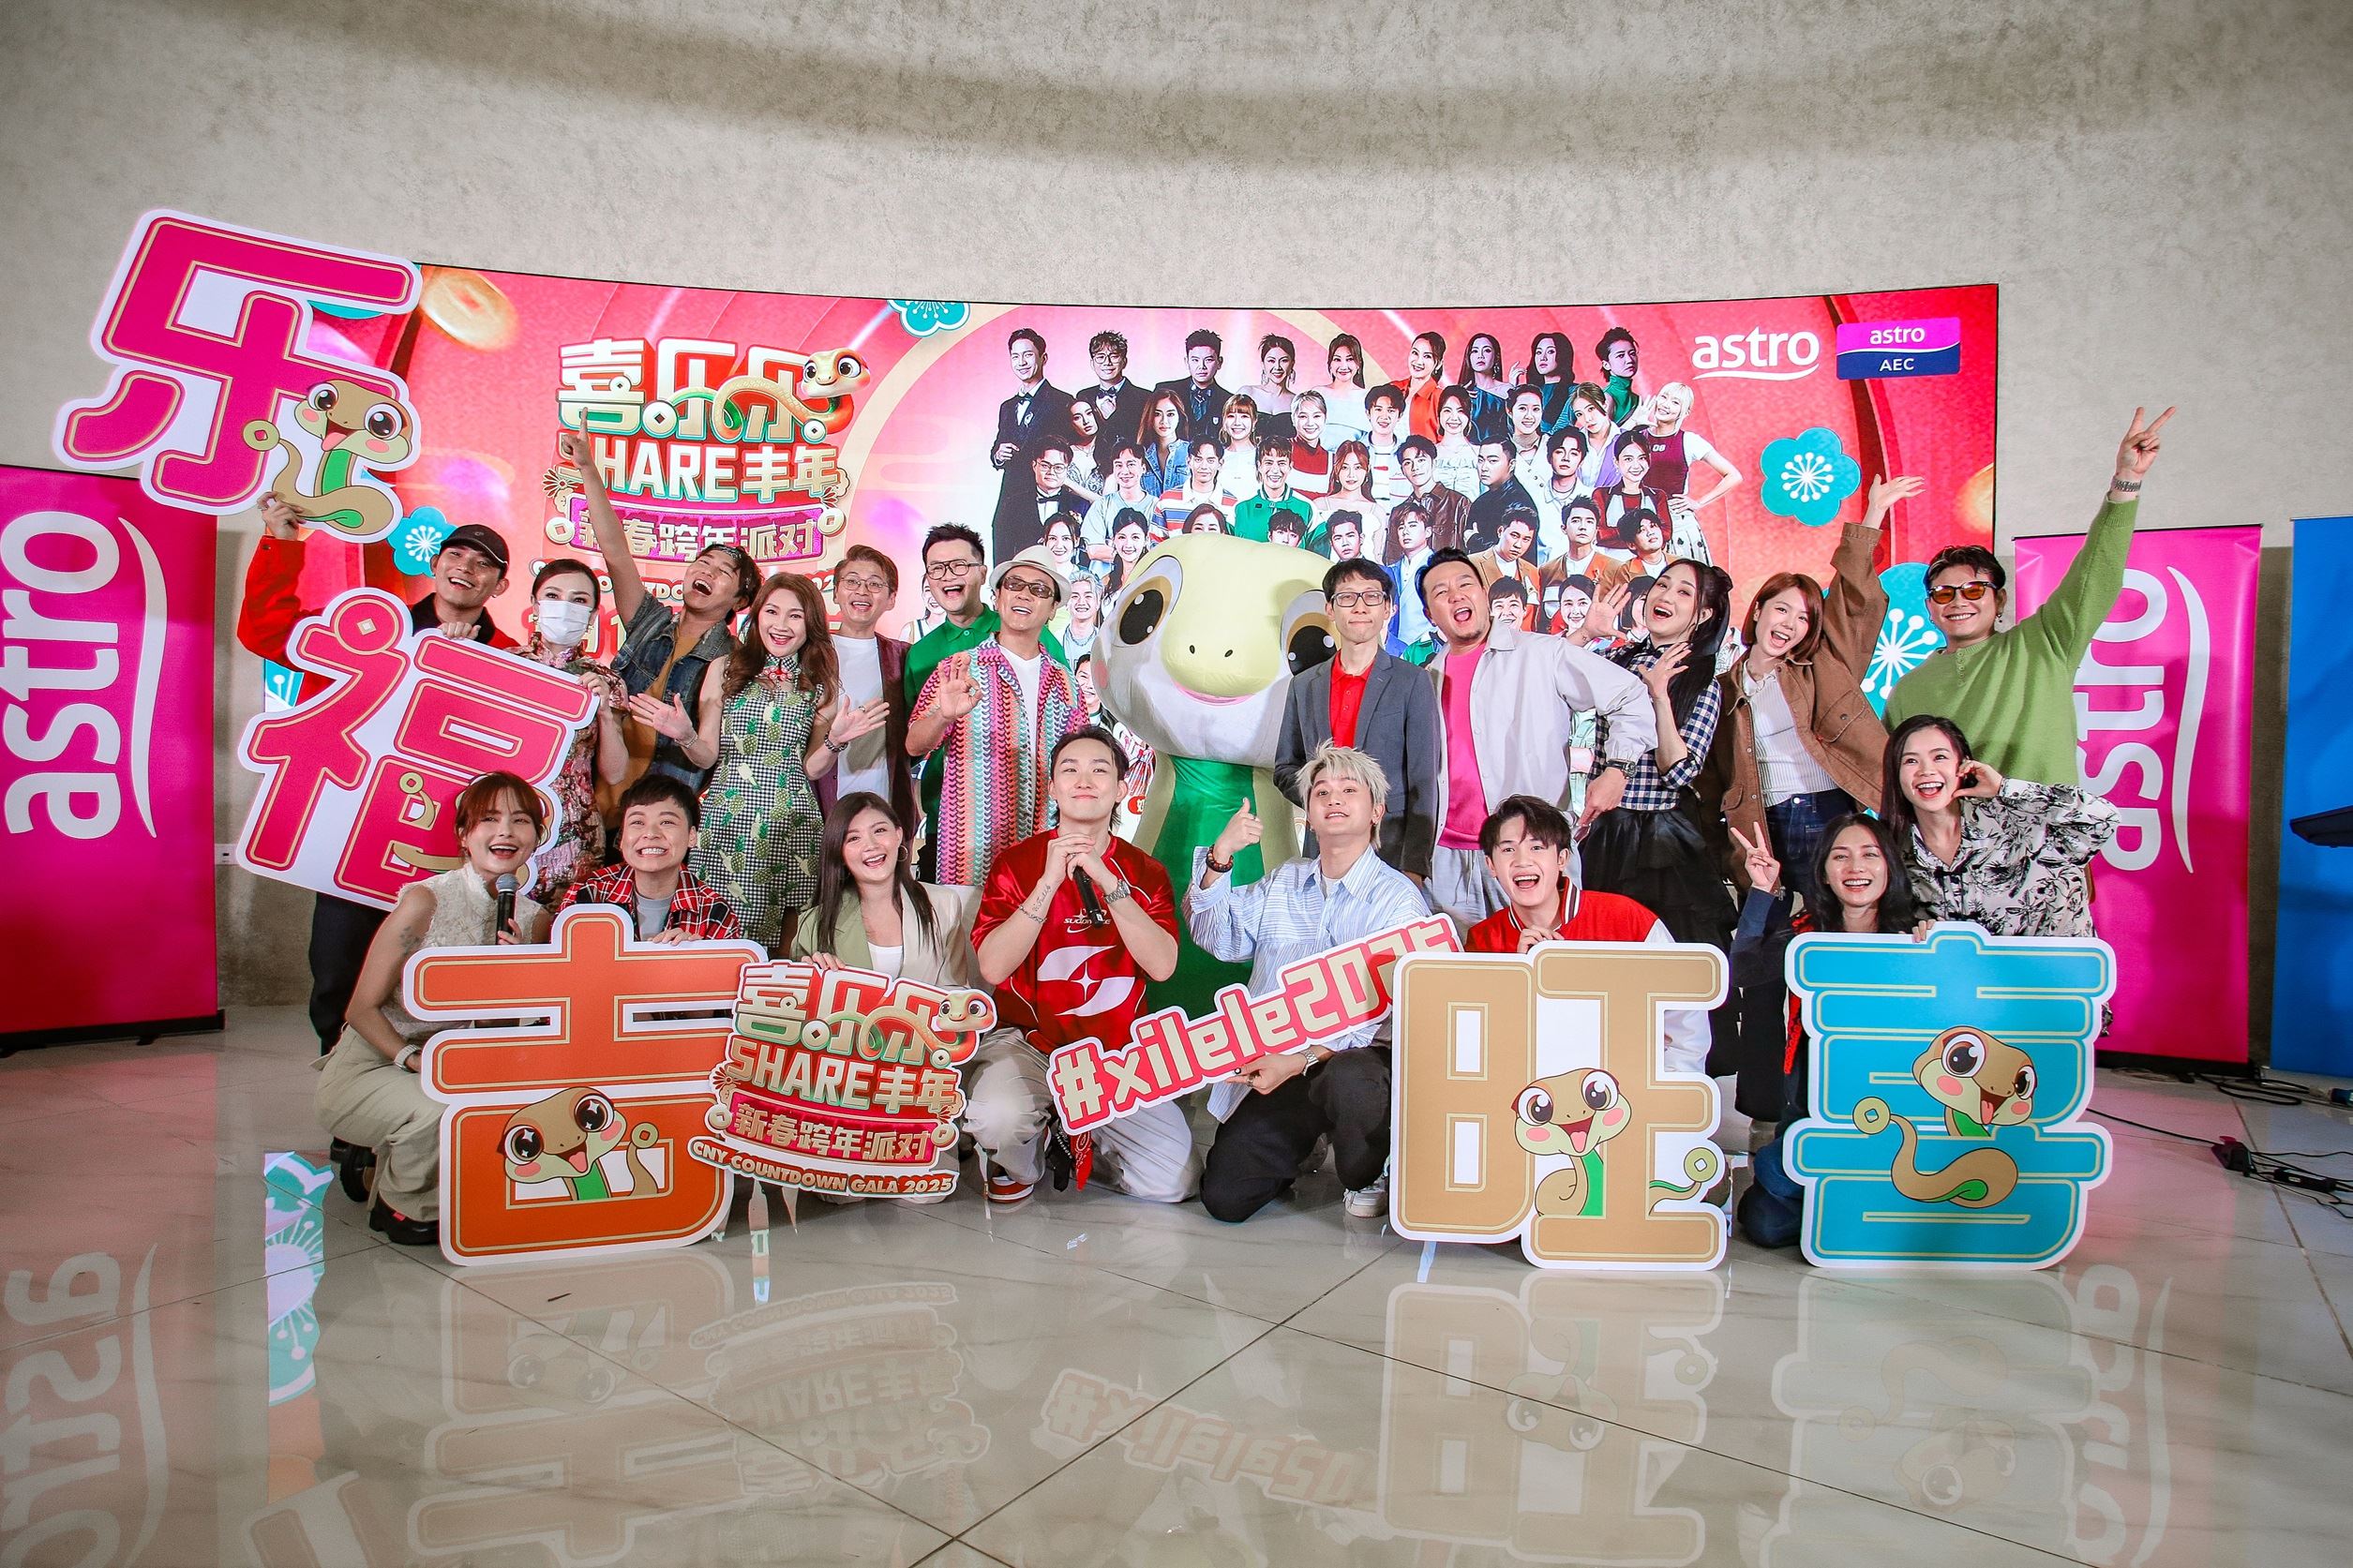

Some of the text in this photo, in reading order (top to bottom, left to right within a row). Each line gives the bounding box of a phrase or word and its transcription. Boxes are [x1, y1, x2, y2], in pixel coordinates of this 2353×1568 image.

[62, 216, 414, 503] 乐
[1691, 326, 1820, 369] astro
[1869, 325, 1926, 345] astro
[1879, 358, 1915, 372] AEC
[743, 446, 838, 502] 丰年
[0, 511, 121, 840] astro
[246, 594, 592, 903] 福
[414, 912, 764, 1257] 吉
[727, 1038, 958, 1113] SHARE 丰年
[1398, 946, 1722, 1262] 旺
[1792, 931, 2111, 1262] 喜
[693, 1141, 952, 1193] CNY COUNTDOWN GALA 2025
[734, 1103, 931, 1161] 新春跨年派对
